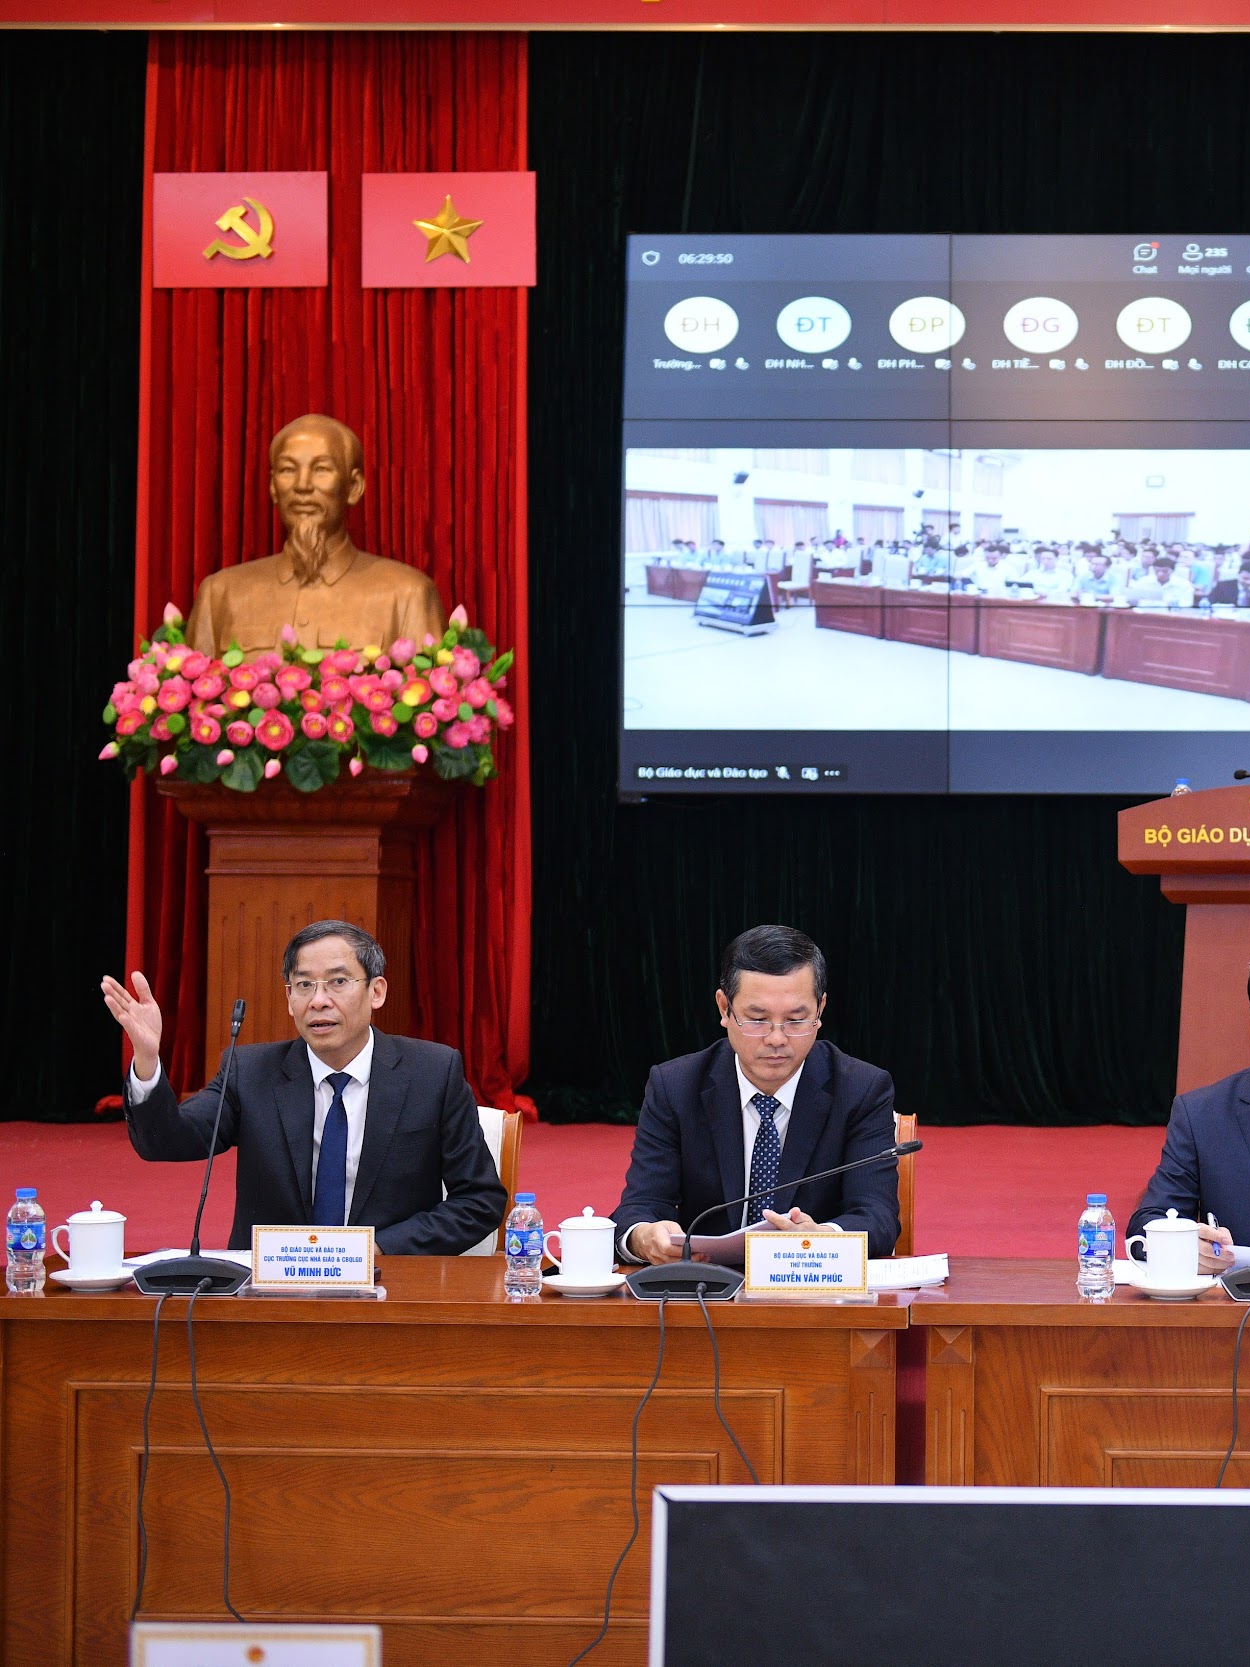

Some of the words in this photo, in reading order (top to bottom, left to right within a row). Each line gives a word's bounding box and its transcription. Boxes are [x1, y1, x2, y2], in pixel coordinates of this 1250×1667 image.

[1204, 248, 1228, 257] 235
[678, 253, 734, 264] 06:29:50
[1132, 265, 1158, 274] Chat
[1178, 265, 1200, 275] Mọi
[680, 317, 720, 333] ĐH
[795, 317, 832, 333] ĐT
[908, 317, 945, 333] ĐP
[1021, 317, 1061, 333] ĐG
[1136, 317, 1172, 333] ĐT
[638, 767, 655, 779] Bộ
[656, 767, 683, 778] Giáo
[684, 767, 706, 779] dục
[707, 767, 722, 778] và
[748, 768, 769, 779] tạo
[1144, 825, 1172, 847] BỘ
[1177, 824, 1224, 844] GIÁO
[281, 1246, 288, 1254] BỘ
[315, 1246, 322, 1254] VÀ
[336, 1247, 346, 1255] TẠO
[285, 1265, 296, 1276] VŨ
[298, 1267, 321, 1276] MINH
[324, 1265, 341, 1276] ĐỨC
[770, 1271, 801, 1282] NGUYỄN
[804, 1272, 819, 1282] VĂN
[821, 1272, 843, 1282] PHÚC
